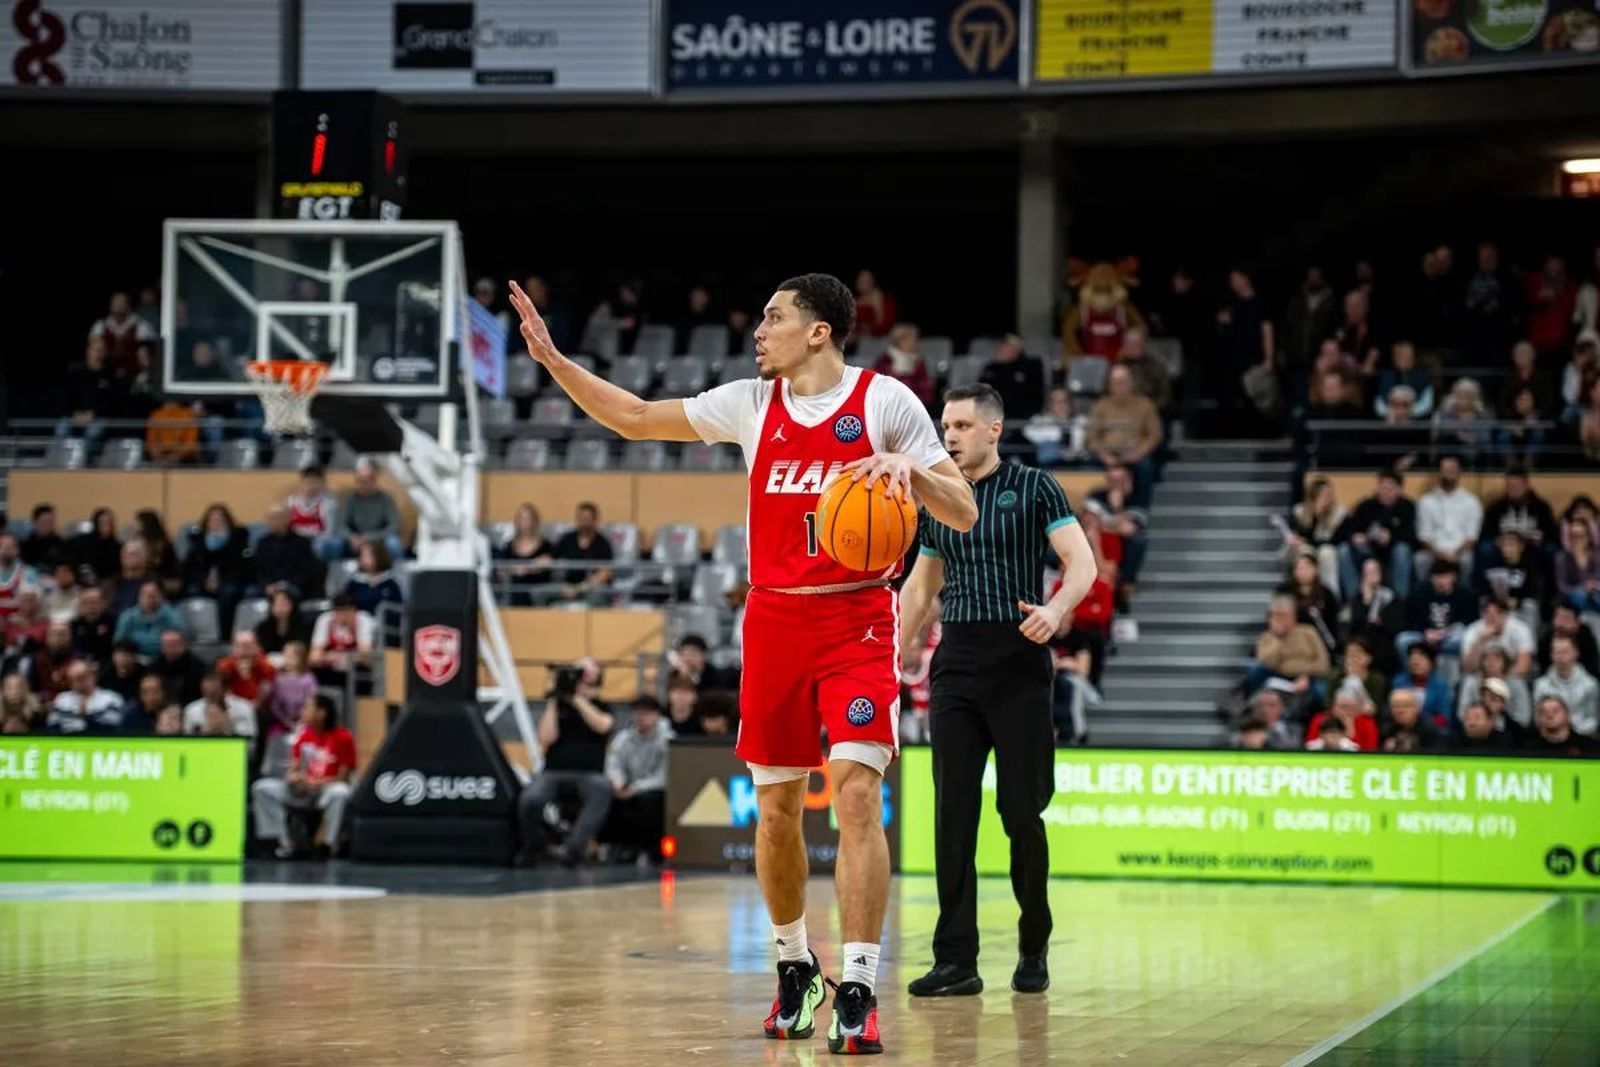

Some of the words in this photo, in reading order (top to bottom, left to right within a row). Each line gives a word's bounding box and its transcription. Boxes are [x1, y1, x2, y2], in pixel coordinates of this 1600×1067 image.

[672, 15, 802, 60] SAÔNE
[825, 18, 936, 56] LOIRE
[48, 750, 85, 780] EN
[92, 751, 164, 780] MAIN
[426, 776, 497, 800] suez
[1151, 763, 1355, 799] D'ENTREPRISE
[1362, 765, 1417, 800] CLÉ
[1427, 771, 1467, 800] EN
[1475, 771, 1553, 804] MAIN
